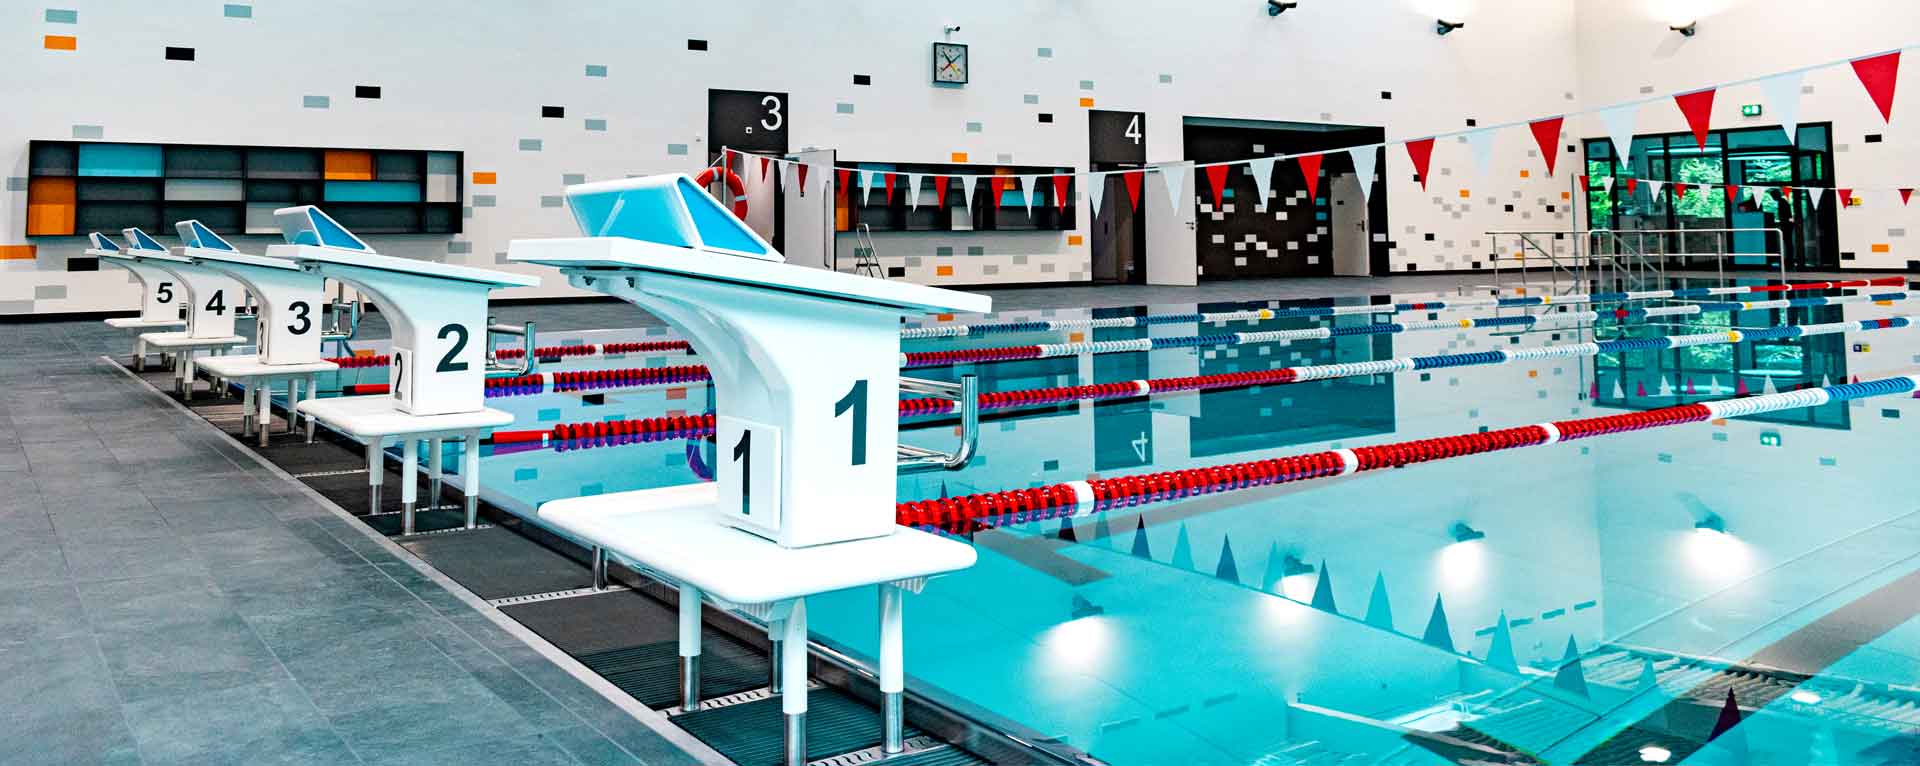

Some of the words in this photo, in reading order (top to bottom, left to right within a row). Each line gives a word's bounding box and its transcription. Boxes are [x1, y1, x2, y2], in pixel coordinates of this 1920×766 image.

[761, 95, 782, 131] 3
[1125, 114, 1142, 145] 4
[156, 282, 173, 303] 5
[205, 289, 226, 316] 4
[287, 301, 311, 335] 3
[436, 323, 469, 373] 2
[394, 351, 403, 400] 2
[834, 379, 868, 466] 1
[733, 429, 751, 515] 1
